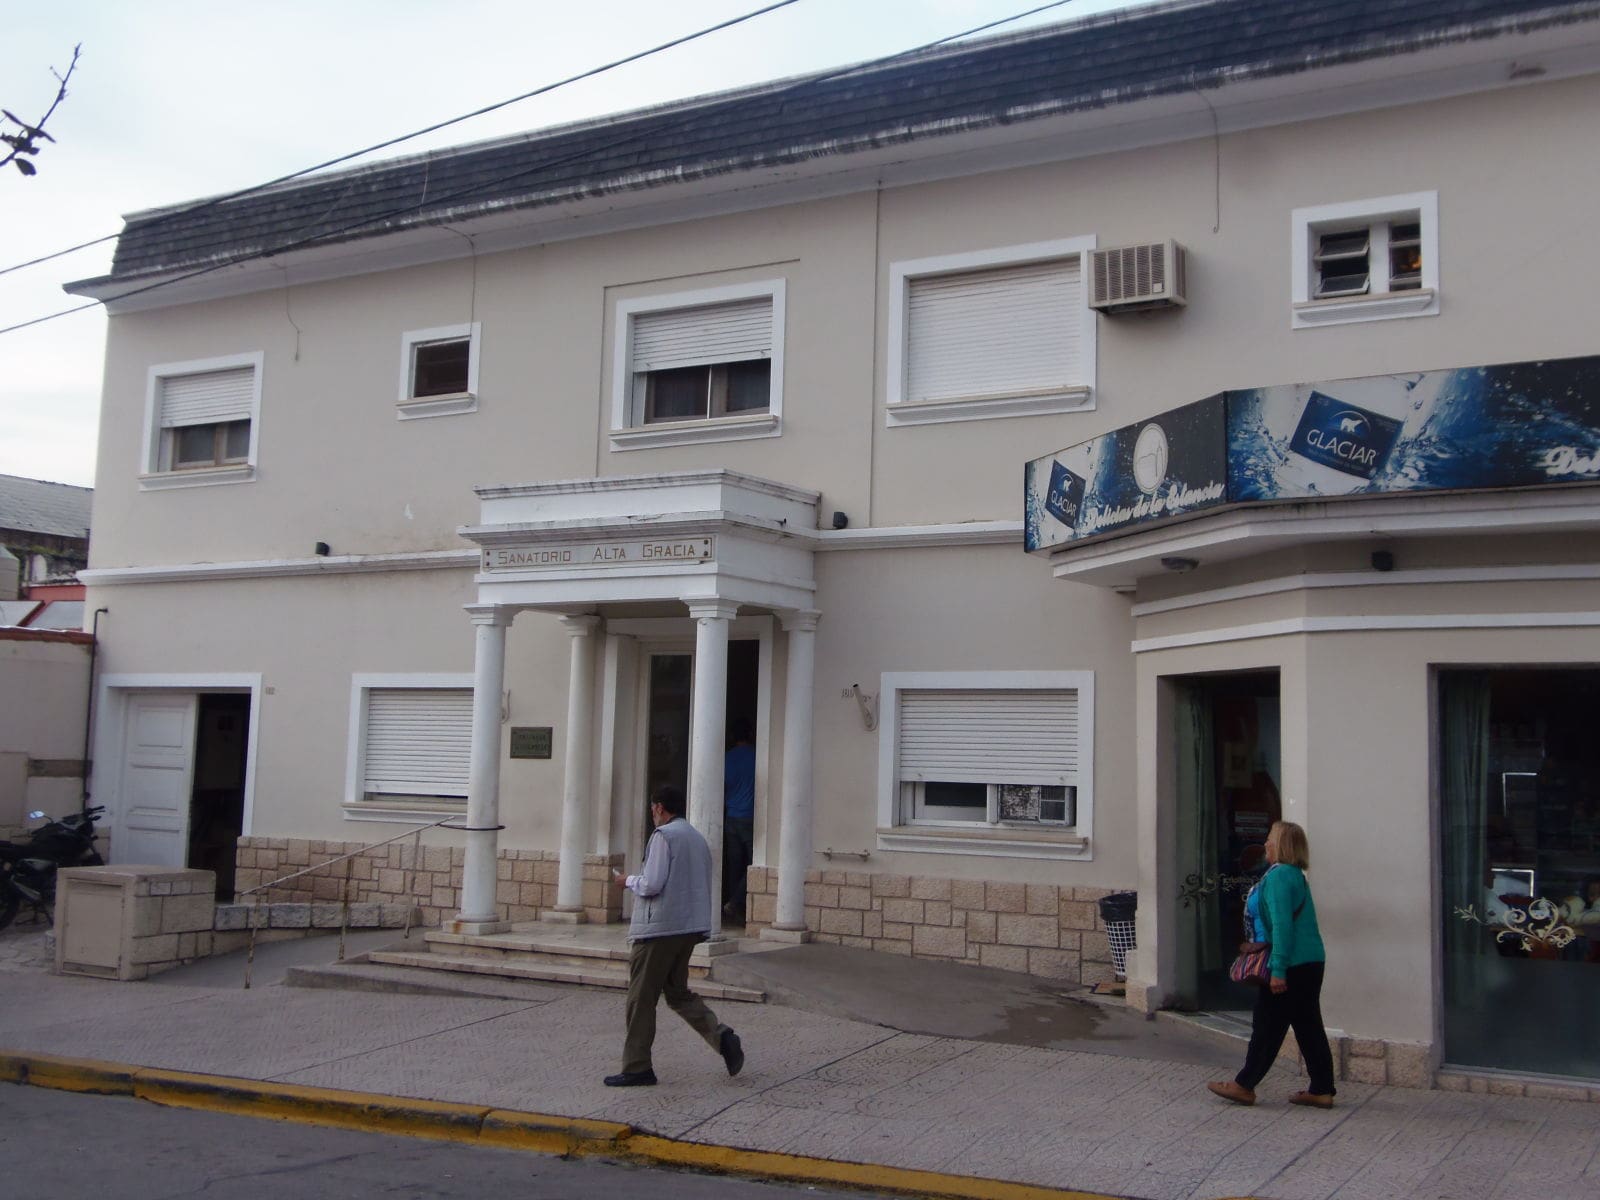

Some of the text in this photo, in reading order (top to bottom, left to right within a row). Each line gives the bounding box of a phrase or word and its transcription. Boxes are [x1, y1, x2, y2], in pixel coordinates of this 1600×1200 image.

[1306, 428, 1377, 466] GLACIAR
[1051, 490, 1077, 517] GLACIAR
[498, 544, 695, 565] SANATORIO ALTA GRACIA
